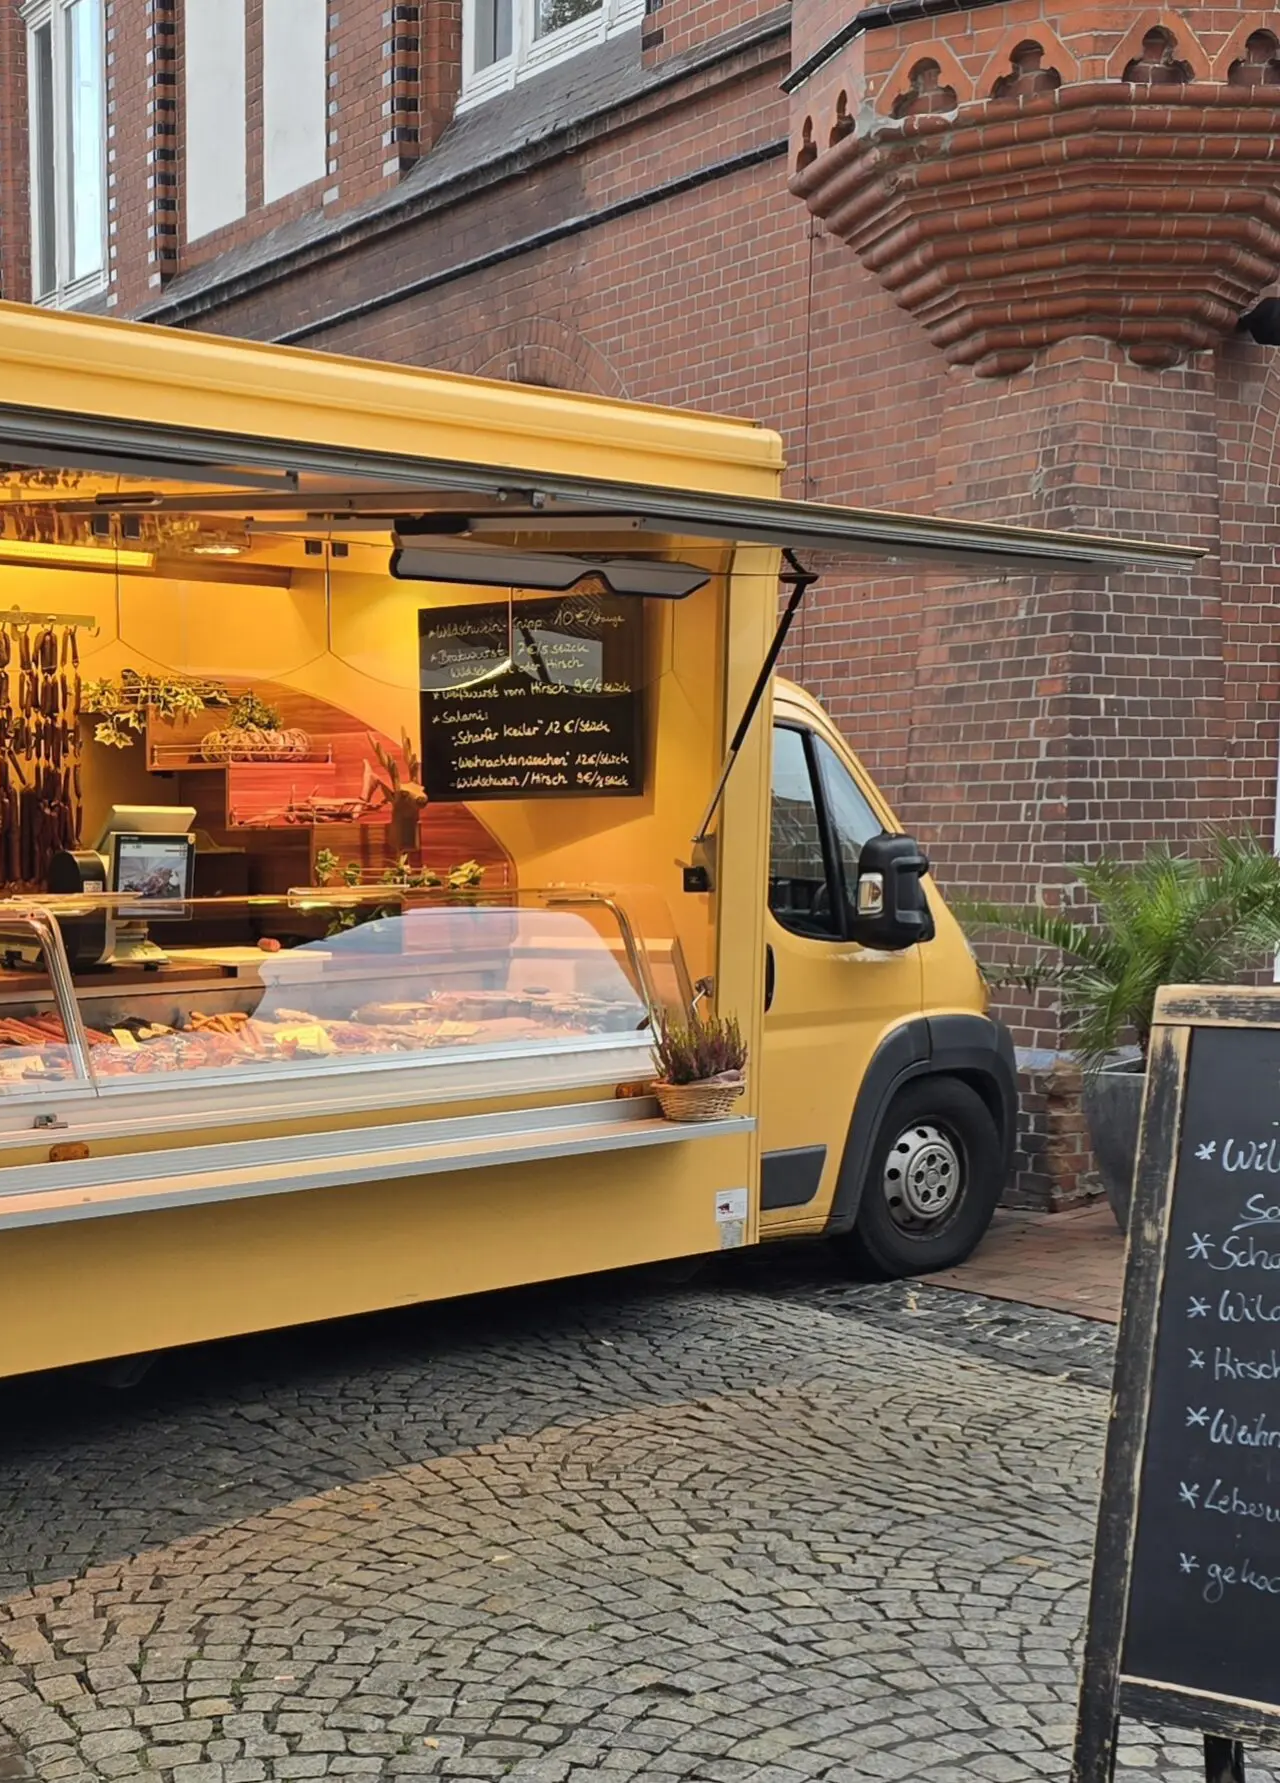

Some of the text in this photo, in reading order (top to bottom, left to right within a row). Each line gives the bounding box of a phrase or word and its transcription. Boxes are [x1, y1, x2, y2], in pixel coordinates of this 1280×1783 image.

[547, 656, 584, 669] Hirsch
[531, 680, 569, 695] Hirsch
[545, 721, 561, 735] 12
